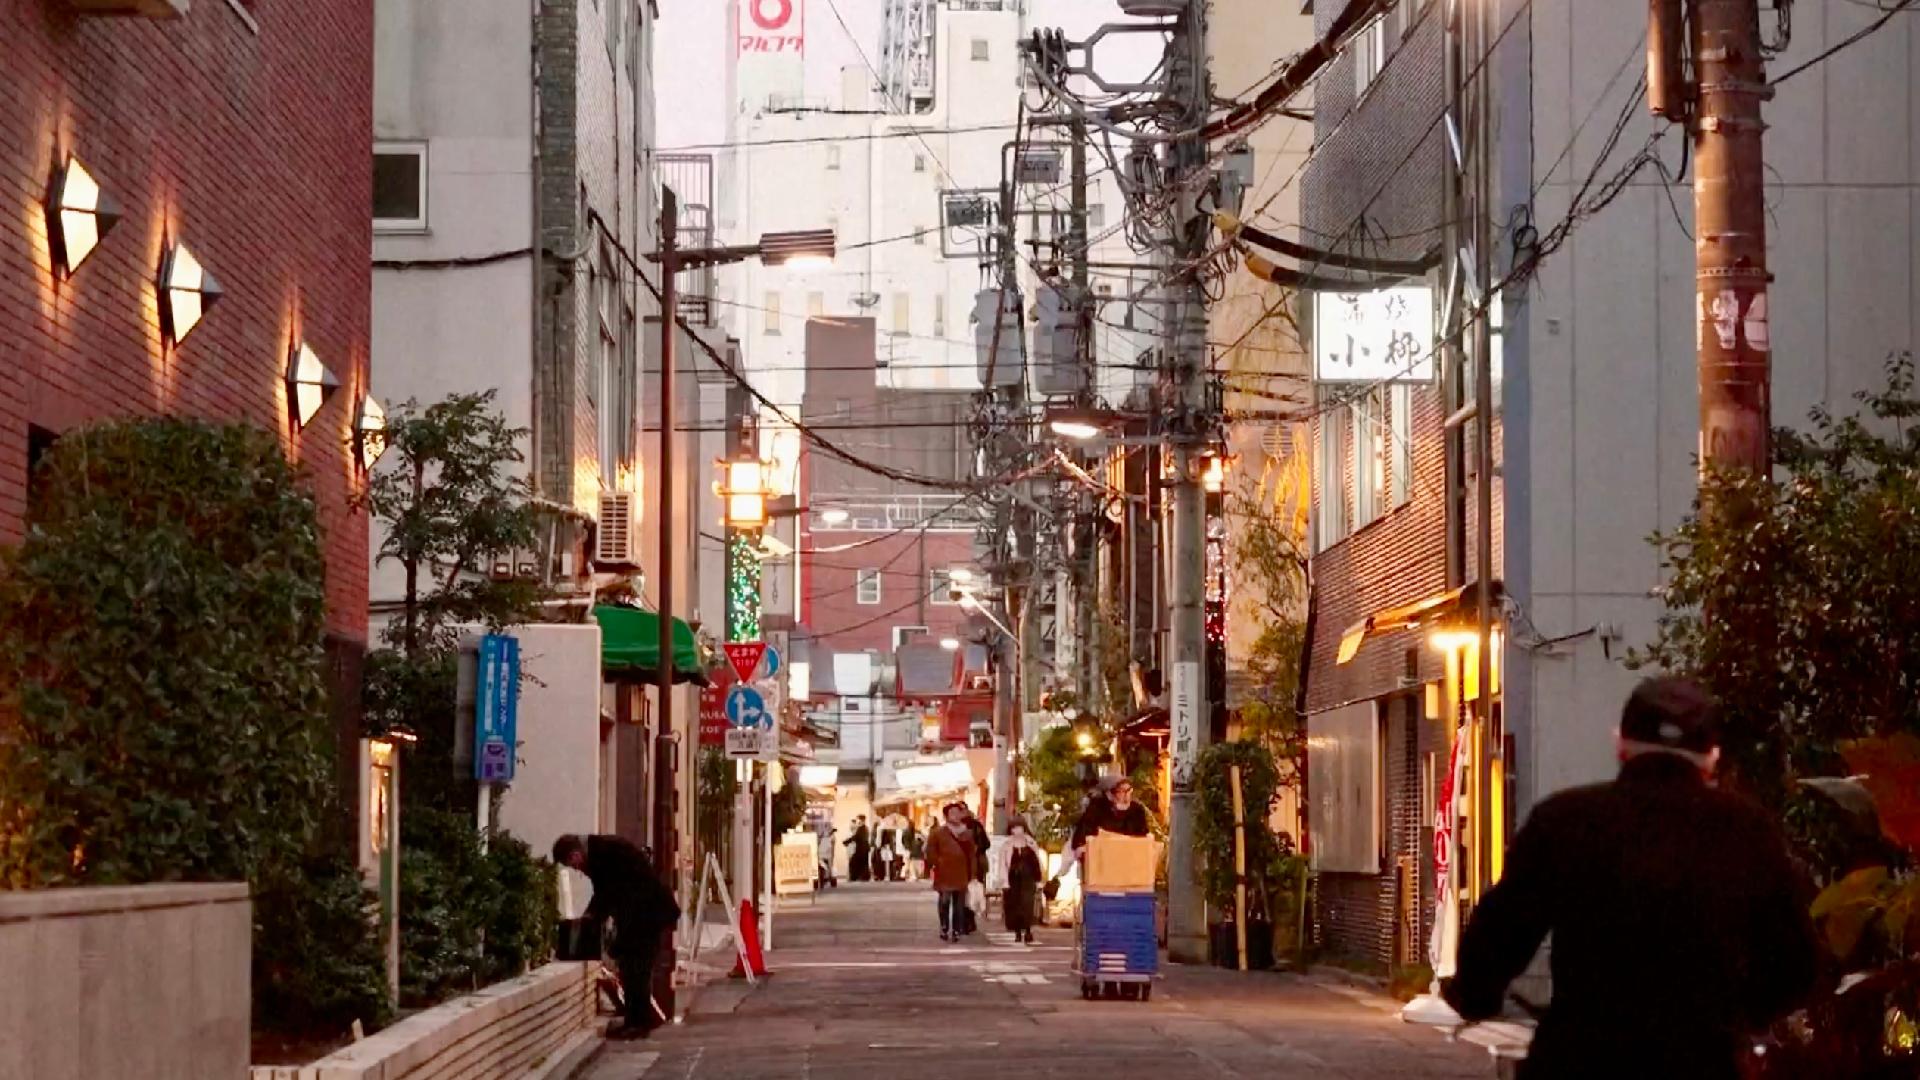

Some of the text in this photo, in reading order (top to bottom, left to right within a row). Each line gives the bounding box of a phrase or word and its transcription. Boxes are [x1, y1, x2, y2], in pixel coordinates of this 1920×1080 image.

[1329, 328, 1421, 376] 小柳
[731, 647, 759, 658] 止まれ
[736, 658, 755, 667] STOP
